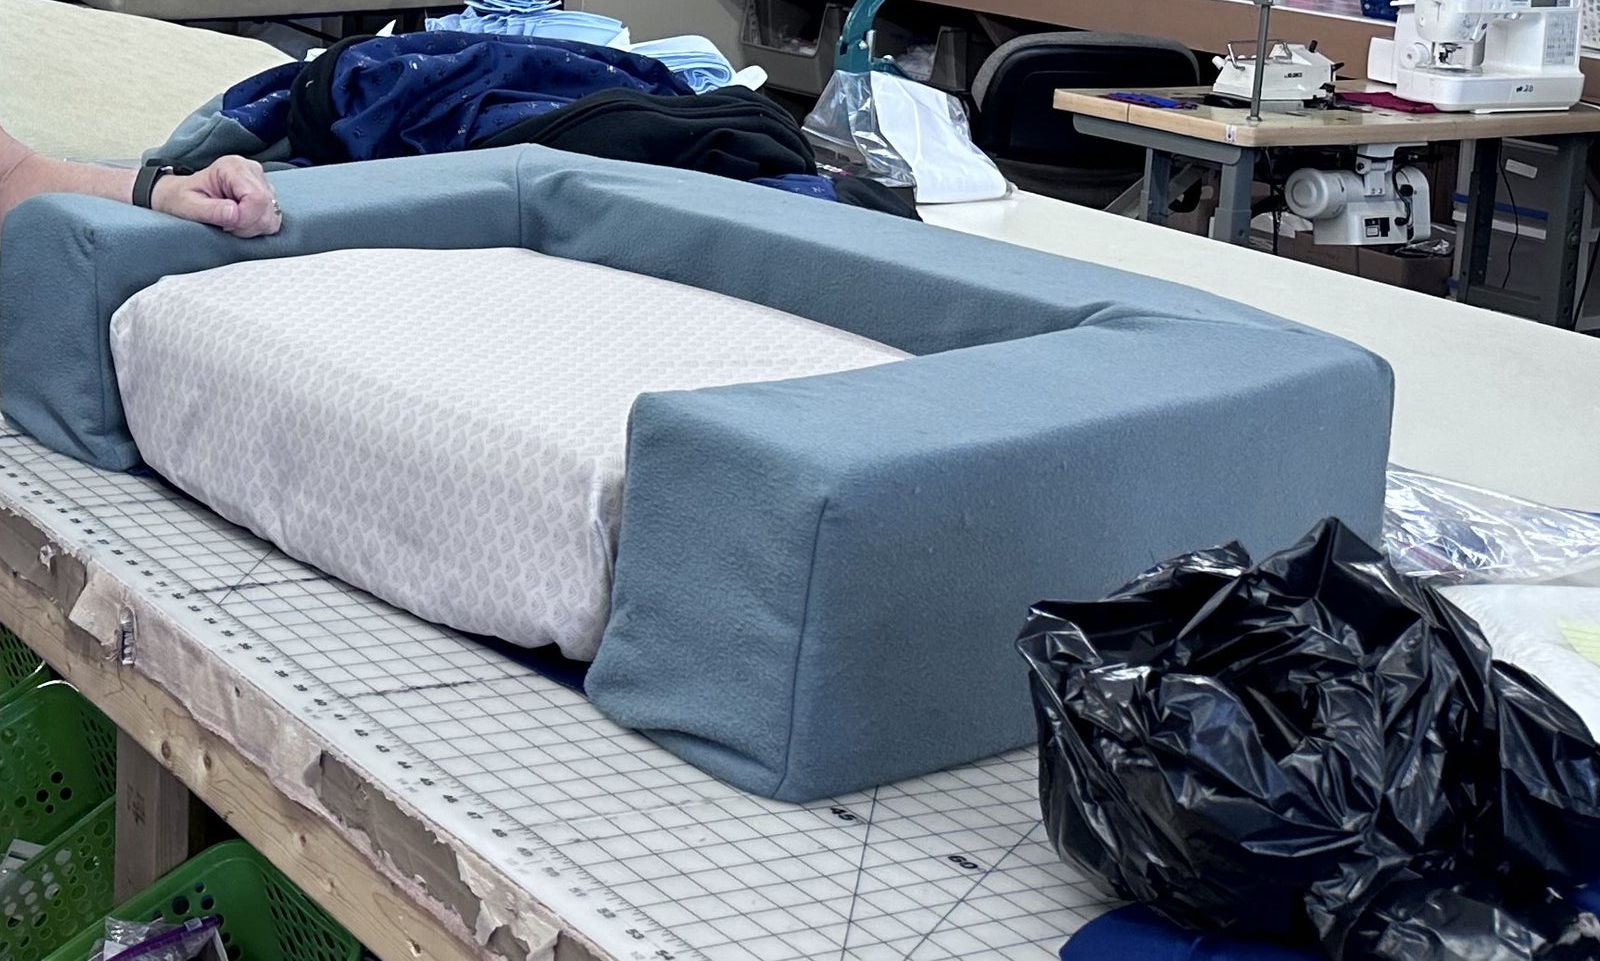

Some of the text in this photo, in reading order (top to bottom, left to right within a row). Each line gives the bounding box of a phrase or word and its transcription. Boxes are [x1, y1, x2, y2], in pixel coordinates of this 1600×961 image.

[313, 697, 329, 706] 40
[354, 728, 369, 736] 42
[375, 744, 391, 753] 43
[397, 760, 413, 769] 44
[419, 777, 436, 786] 45
[442, 794, 459, 803] 46
[466, 811, 484, 819] 47
[491, 828, 507, 837] 48
[568, 887, 587, 897] 51
[596, 907, 616, 919] 52
[625, 928, 645, 939] 53
[655, 949, 675, 961] 54
[947, 855, 978, 869] 60
